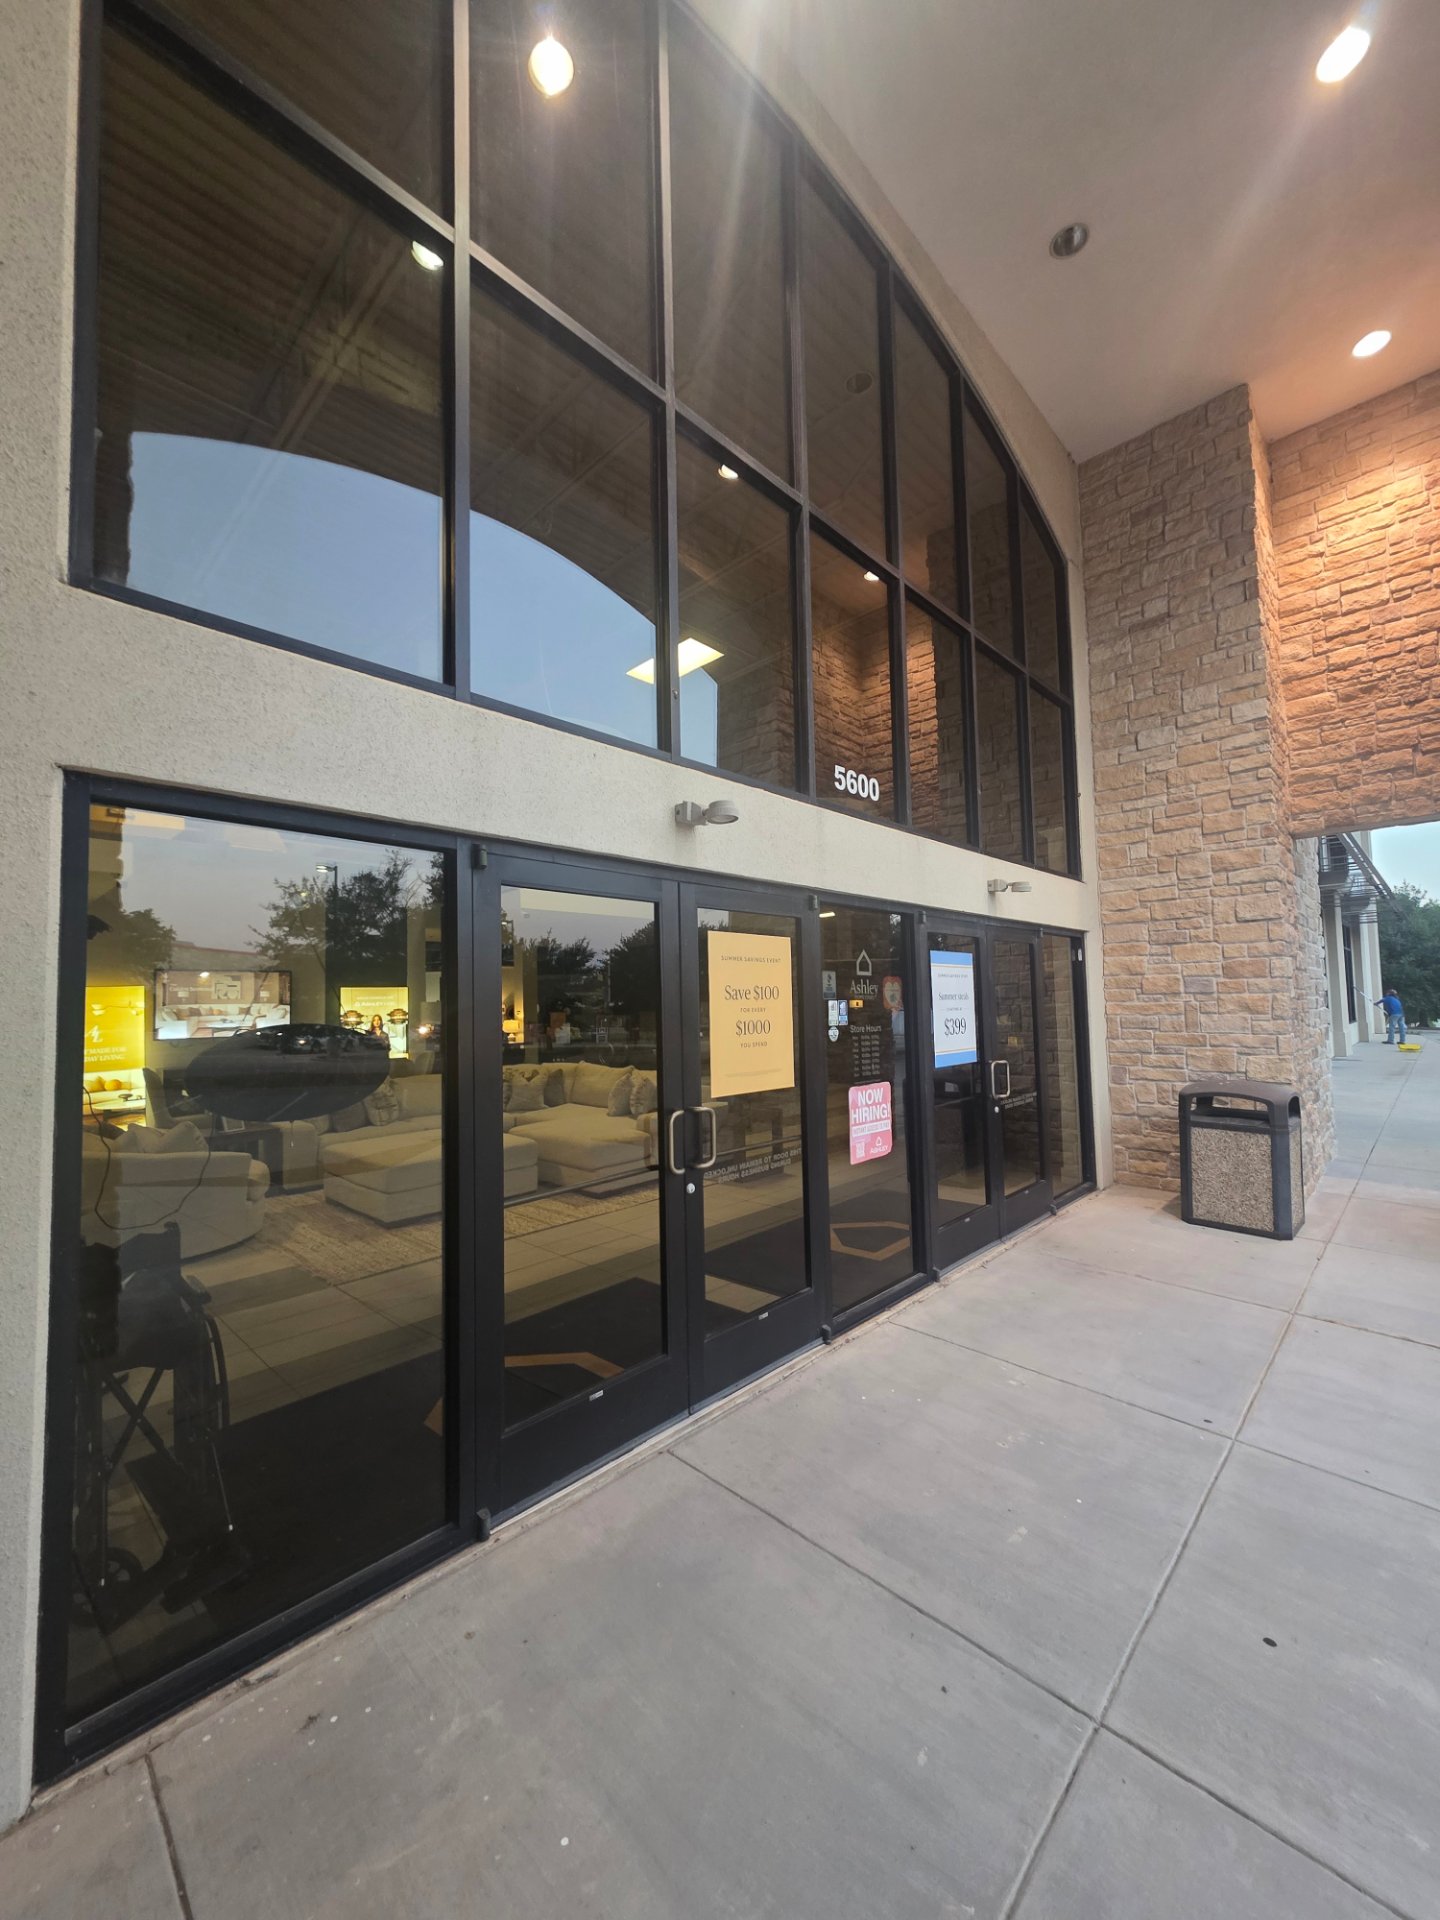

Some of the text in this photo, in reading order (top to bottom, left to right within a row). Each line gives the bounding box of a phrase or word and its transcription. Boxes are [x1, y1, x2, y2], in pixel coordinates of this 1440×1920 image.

[834, 765, 879, 801] 5600
[724, 985, 780, 1002] Save $100
[850, 979, 879, 997] Ashley
[938, 992, 957, 1001] Summer
[736, 1020, 771, 1037] $1000
[850, 1024, 882, 1033] Store Hours
[944, 1017, 967, 1038] $399
[857, 1088, 884, 1107] NOW
[851, 1103, 891, 1125] HIRING!
